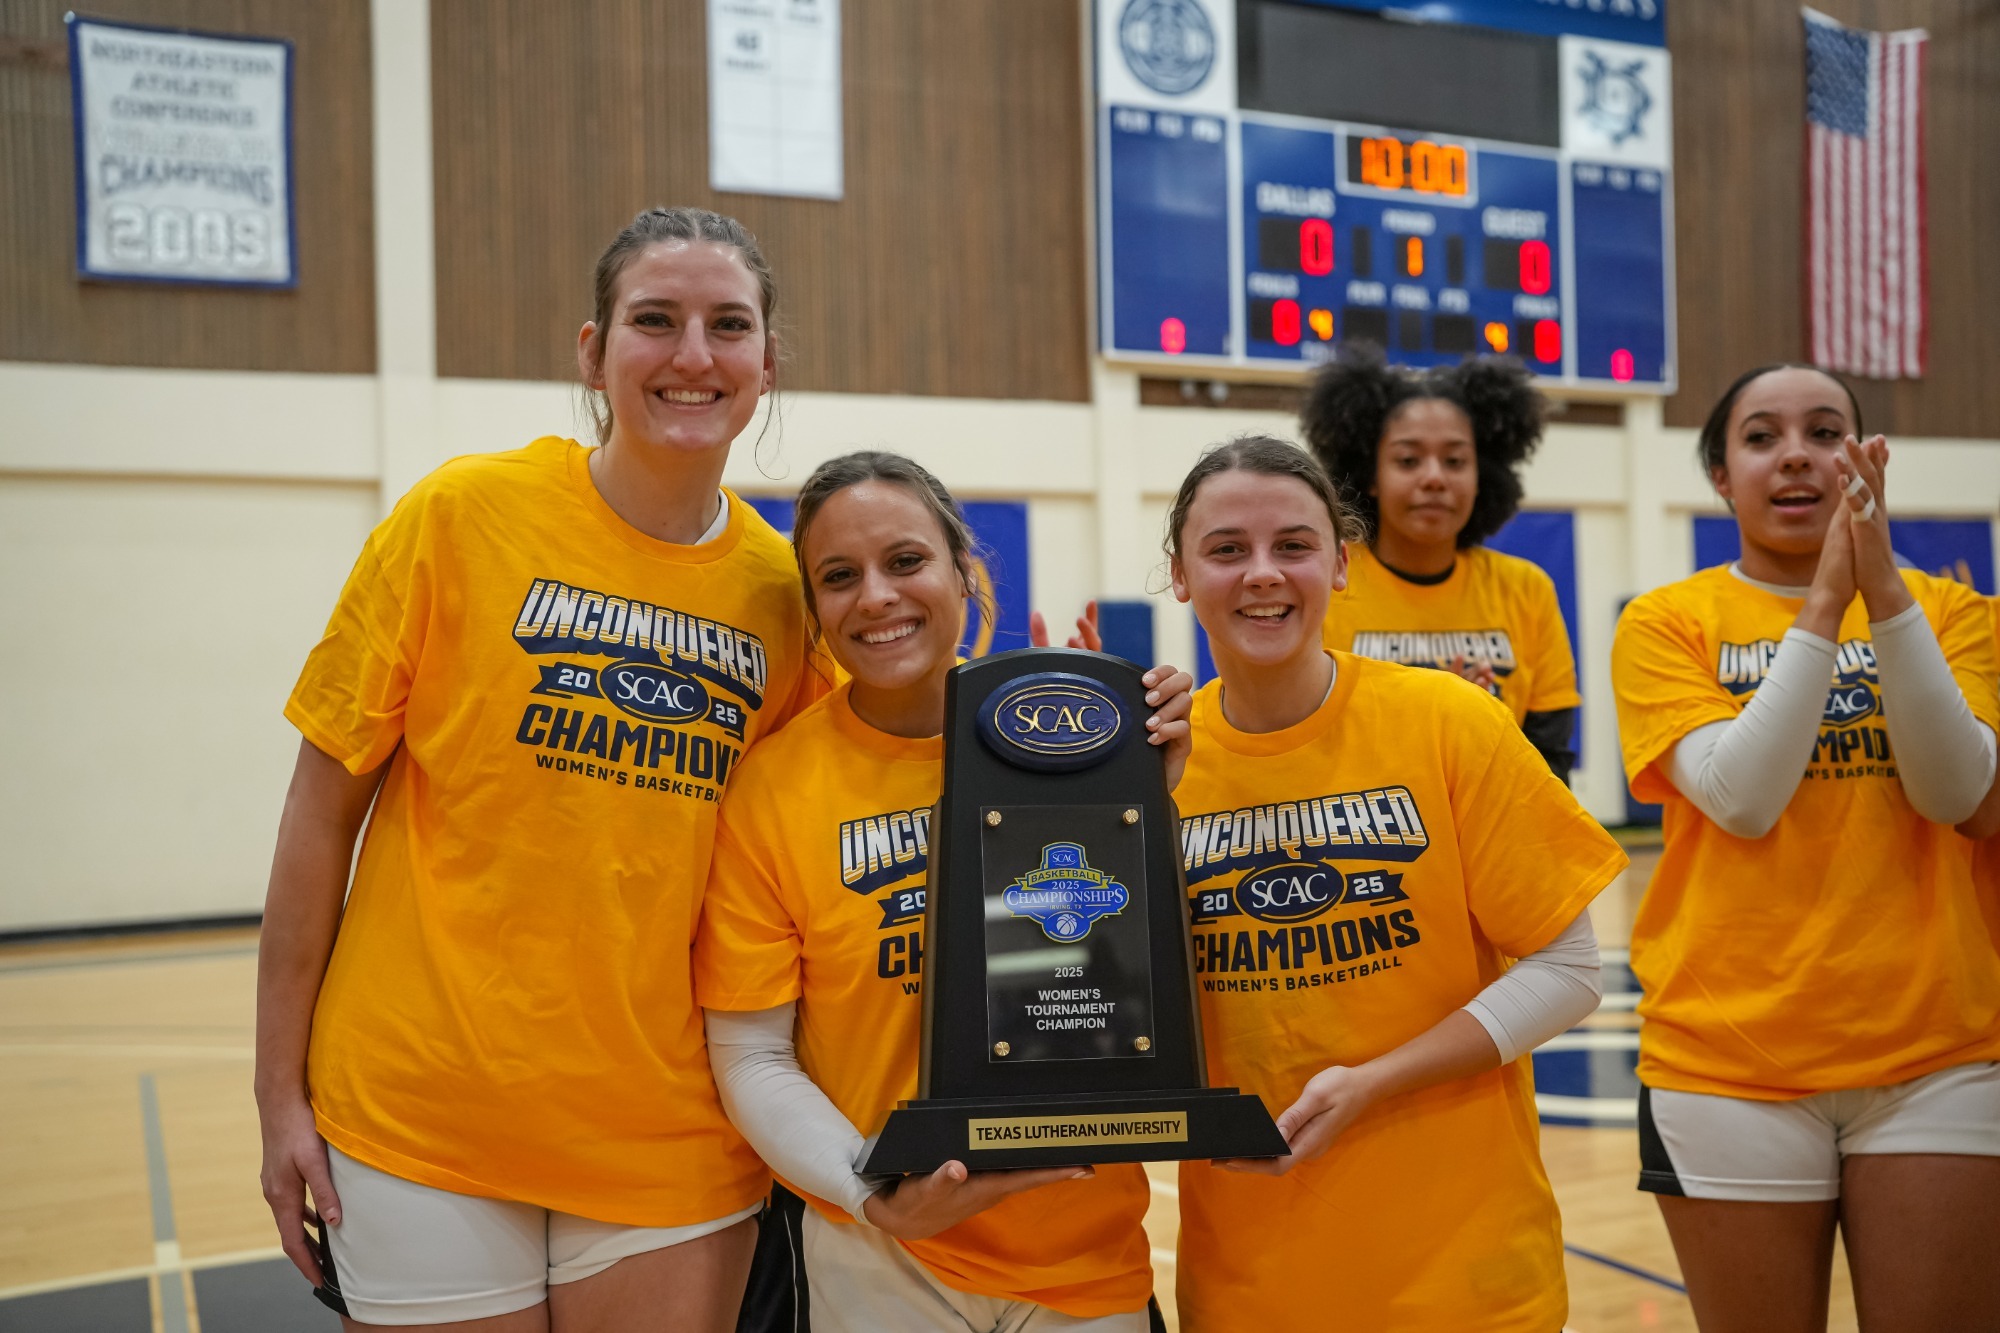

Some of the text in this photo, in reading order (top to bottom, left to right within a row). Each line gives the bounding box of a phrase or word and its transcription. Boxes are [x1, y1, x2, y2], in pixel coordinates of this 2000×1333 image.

[131, 73, 235, 98] ATHLETIC
[110, 96, 257, 127] CONFERENCE
[100, 153, 274, 206] CHAMPIONS
[1361, 135, 1469, 198] 10:00
[1257, 182, 1336, 218] DALLAS
[1300, 219, 1334, 277] 0
[1519, 240, 1551, 295] 0
[512, 578, 768, 704] UNCONQUERED
[557, 668, 738, 724] 20 SCAC 25
[1014, 704, 1101, 734] SCAC
[535, 754, 627, 785] WOMEN'S
[1052, 854, 1076, 863] SCAC
[1031, 869, 1099, 883] BASKETBALL
[1052, 880, 1080, 890] 2025
[1006, 888, 1124, 906] CHAMPIONSHIPS
[1202, 873, 1385, 912] 20 SCAC 25
[1055, 966, 1083, 978] 2025
[1203, 955, 1403, 993] WOMEN'S BASKETBALL
[1025, 1002, 1116, 1016] TOURNAMENT
[1038, 988, 1101, 1001] WOMEN'S
[1036, 1017, 1106, 1031] CHAMPION
[976, 1120, 1181, 1141] TEXAS LUTHERAN UNIVERSITY
